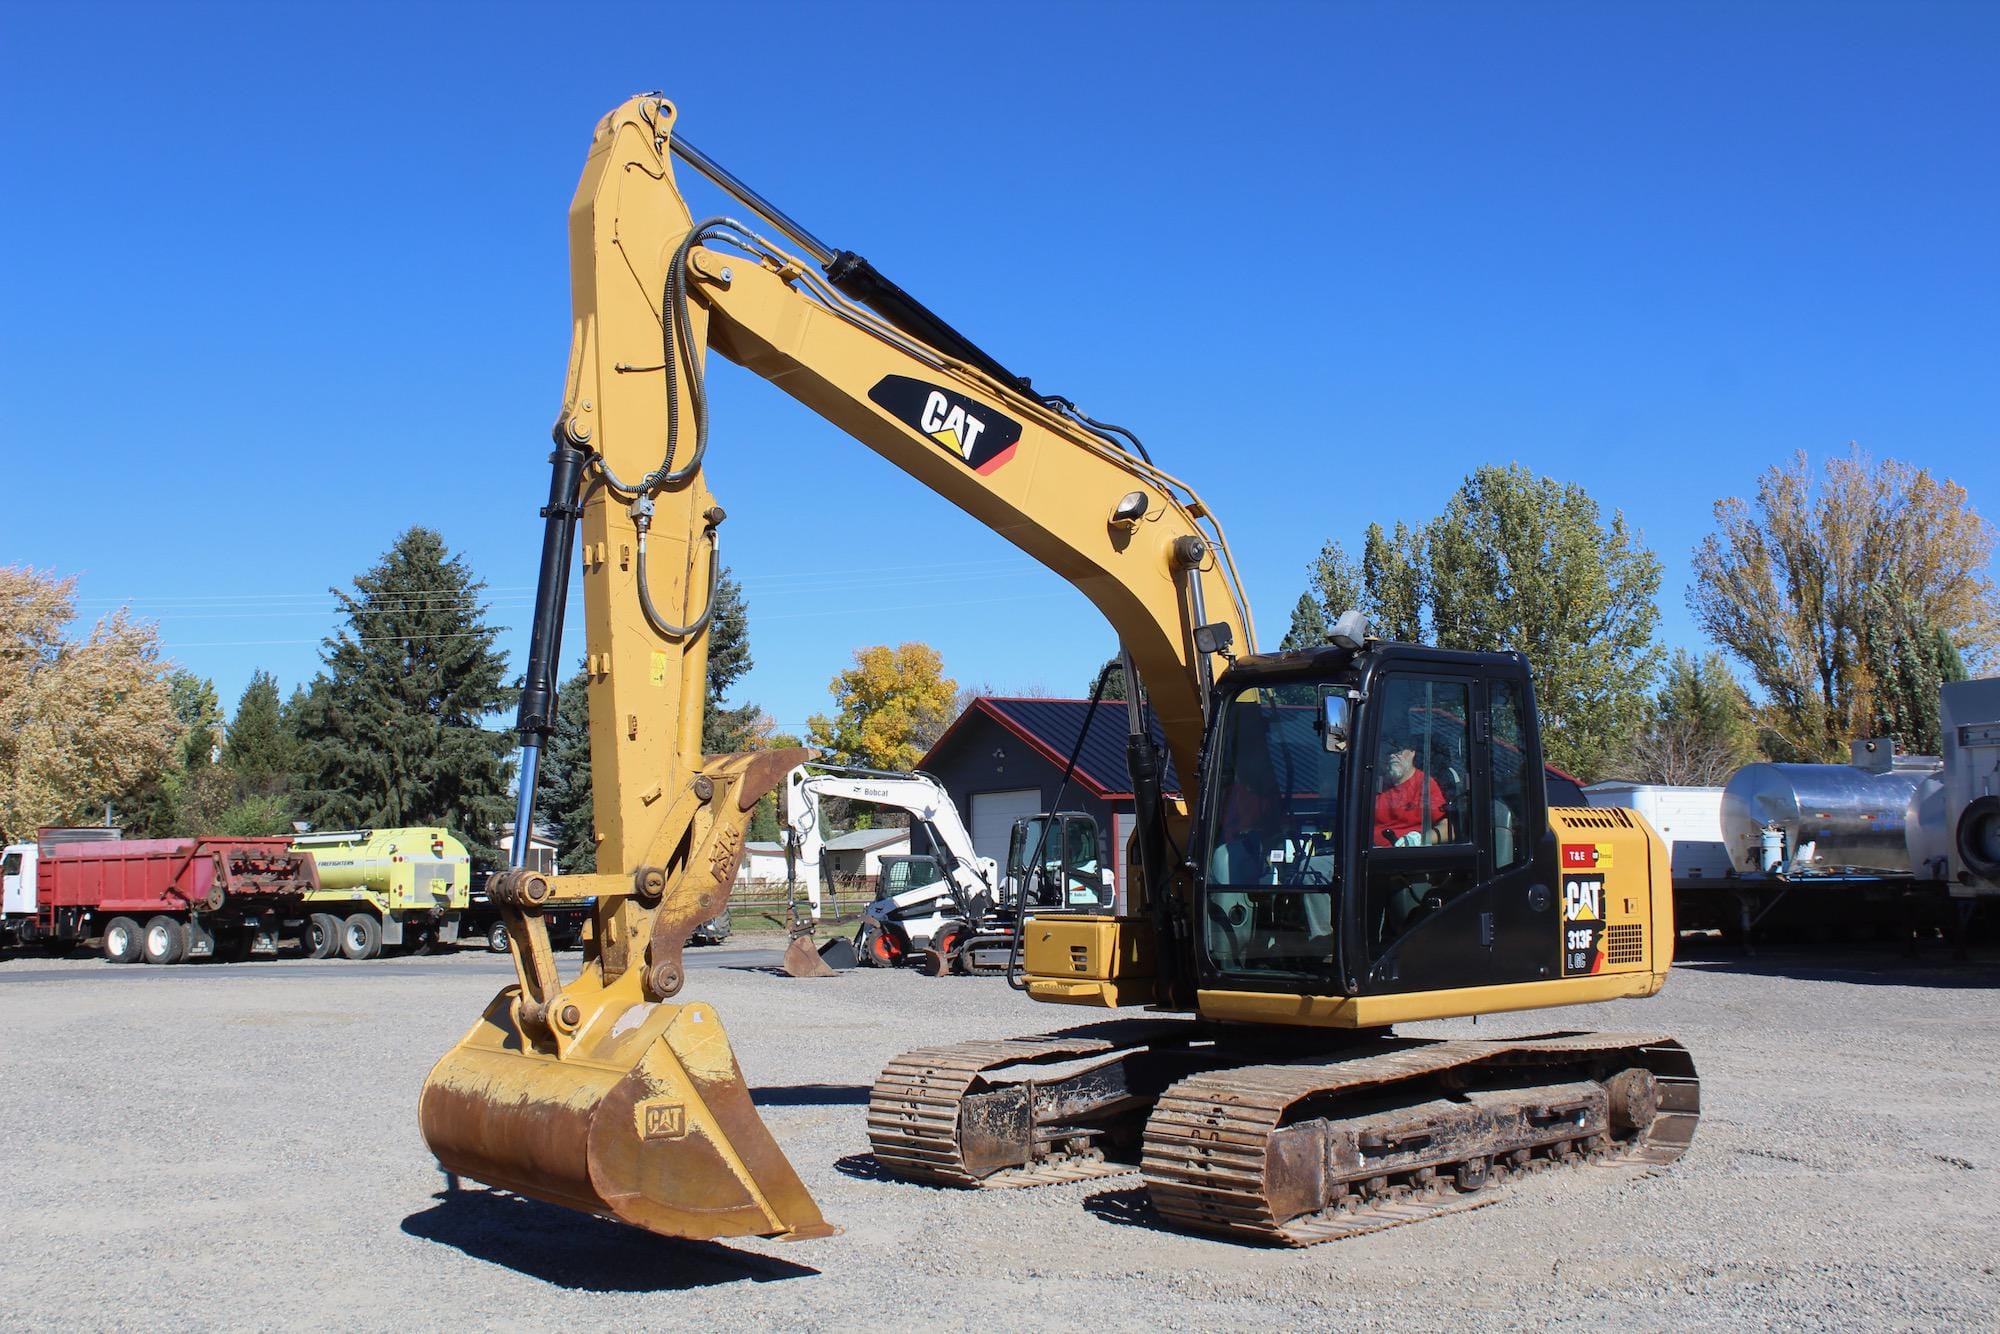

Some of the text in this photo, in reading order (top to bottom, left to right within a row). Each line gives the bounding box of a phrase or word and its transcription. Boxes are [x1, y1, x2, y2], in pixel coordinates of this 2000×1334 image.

[920, 390, 986, 461] CAT
[864, 787, 889, 797] Bobcat
[1569, 851, 1586, 861] T&E
[1566, 881, 1601, 921] CAT
[1567, 929, 1592, 950] 313F
[1567, 952, 1586, 969] L GC
[647, 1108, 683, 1134] CAT
